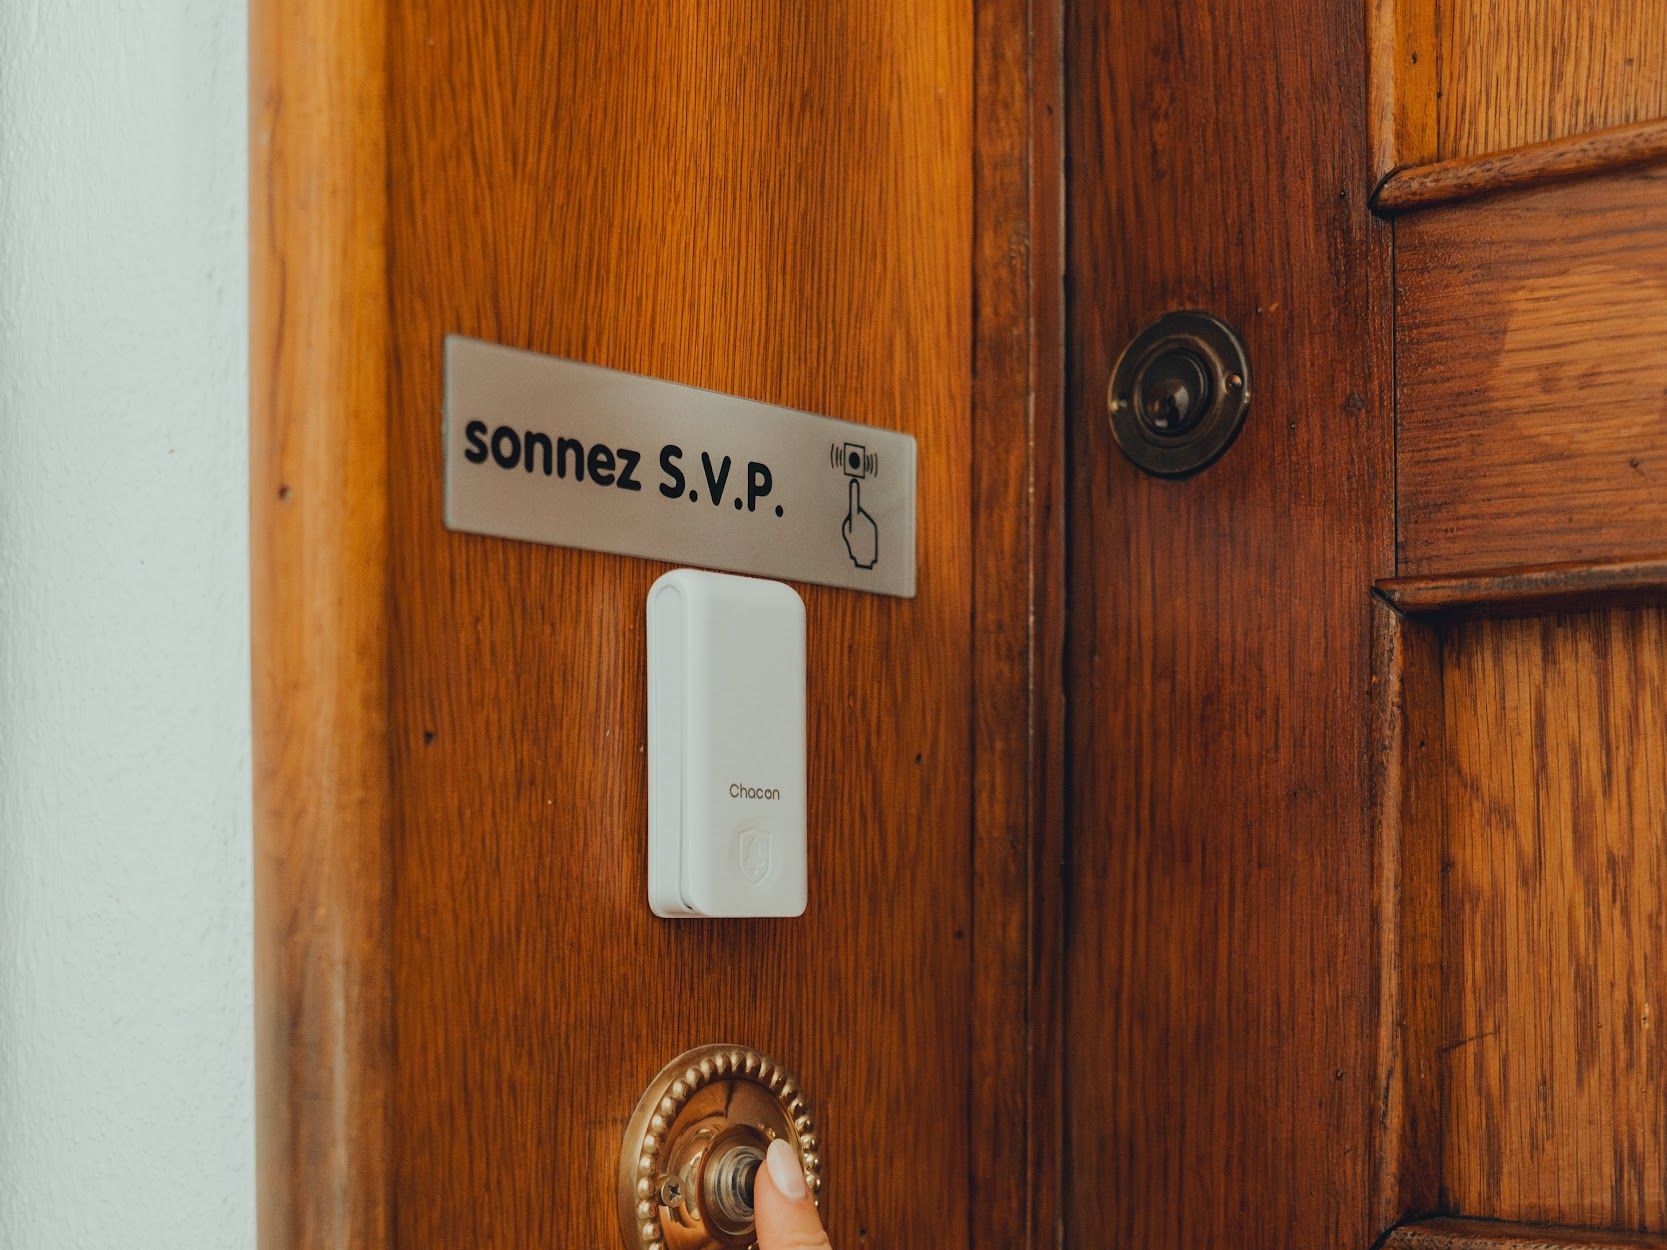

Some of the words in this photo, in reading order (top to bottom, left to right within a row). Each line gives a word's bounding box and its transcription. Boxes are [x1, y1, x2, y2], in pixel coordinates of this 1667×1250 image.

[464, 420, 642, 491] sonnez
[658, 444, 784, 517] S.V.P.
[729, 783, 780, 800] Chacon
